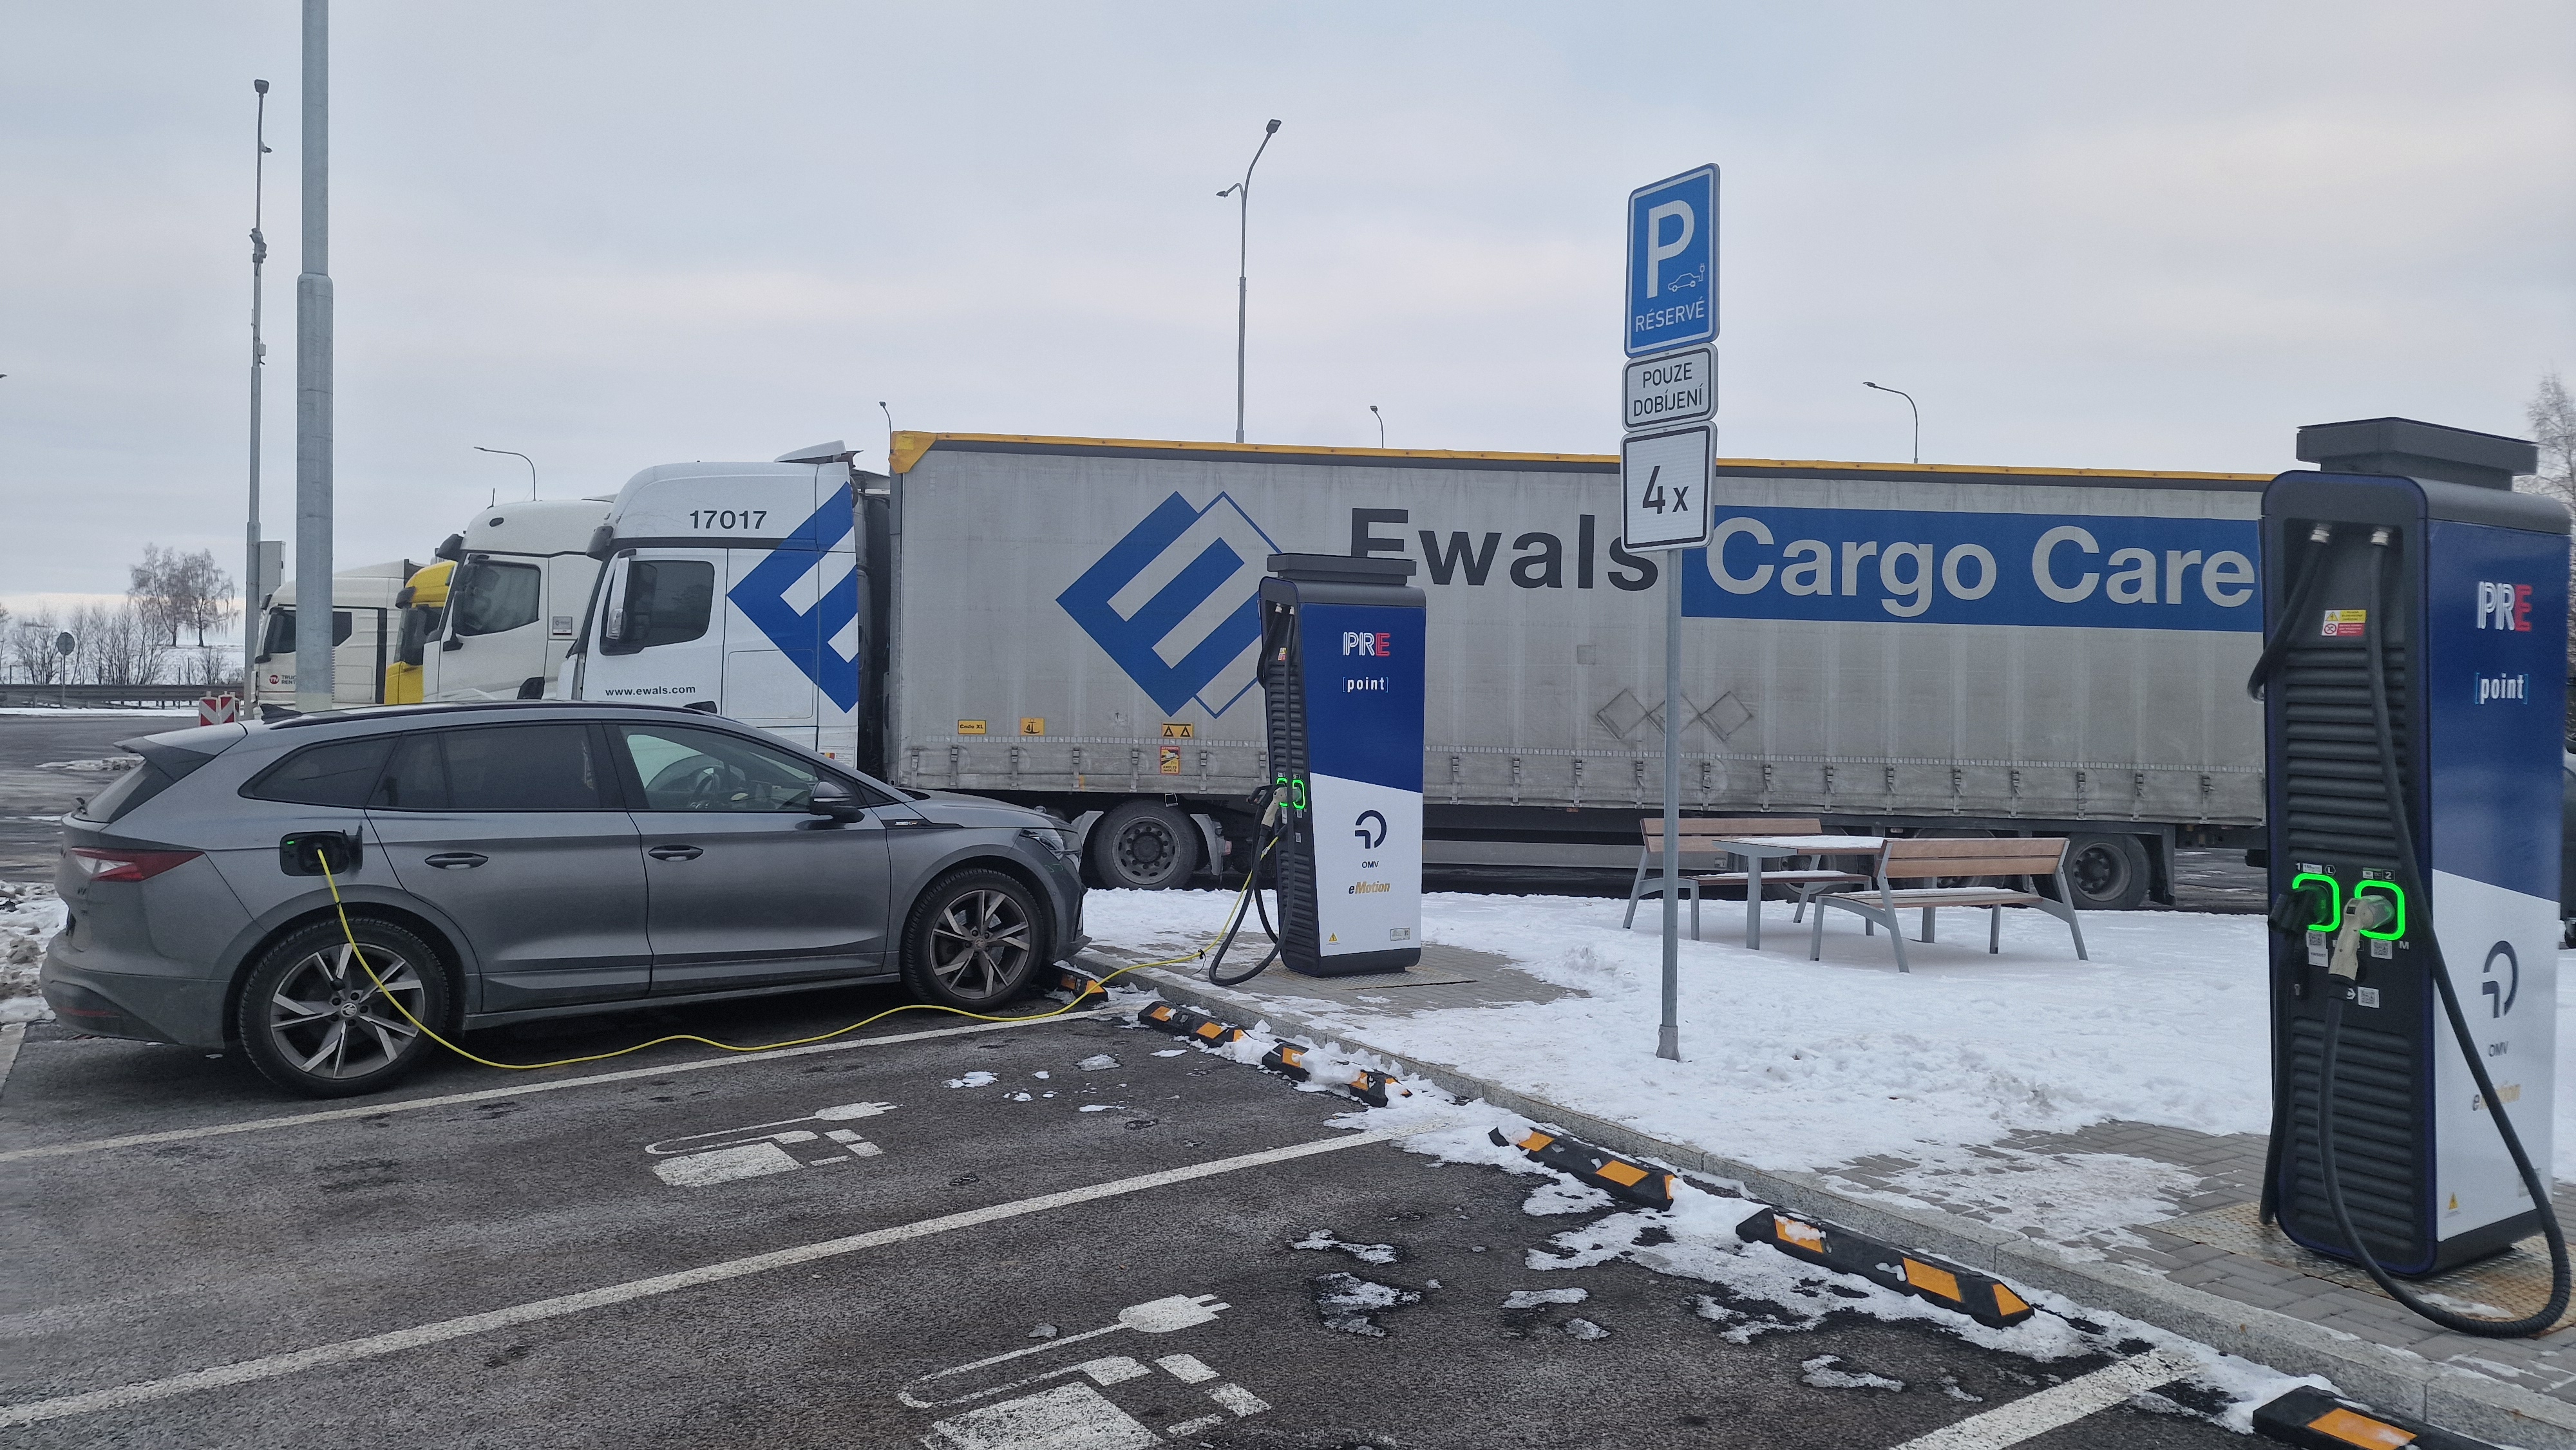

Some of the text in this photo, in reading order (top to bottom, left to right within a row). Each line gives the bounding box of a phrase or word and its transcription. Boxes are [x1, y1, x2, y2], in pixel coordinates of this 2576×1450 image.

[1647, 200, 1695, 299] P
[1636, 296, 1705, 332] RÉSERVÉ
[1643, 362, 1692, 388] POUZE
[1634, 383, 1703, 417] DOBÍJENÍ
[689, 510, 767, 529] 17017
[1351, 507, 2255, 618] Ewals Cargo Care
[2477, 581, 2533, 632] PRE
[1343, 632, 1390, 656] PRE
[605, 686, 696, 696] www.ewals.com
[1361, 860, 1379, 869] OMV
[2385, 871, 2392, 880] 2
[1348, 880, 1390, 894] eMotion
[2399, 940, 2410, 950] M
[2488, 1040, 2509, 1057] OMV
